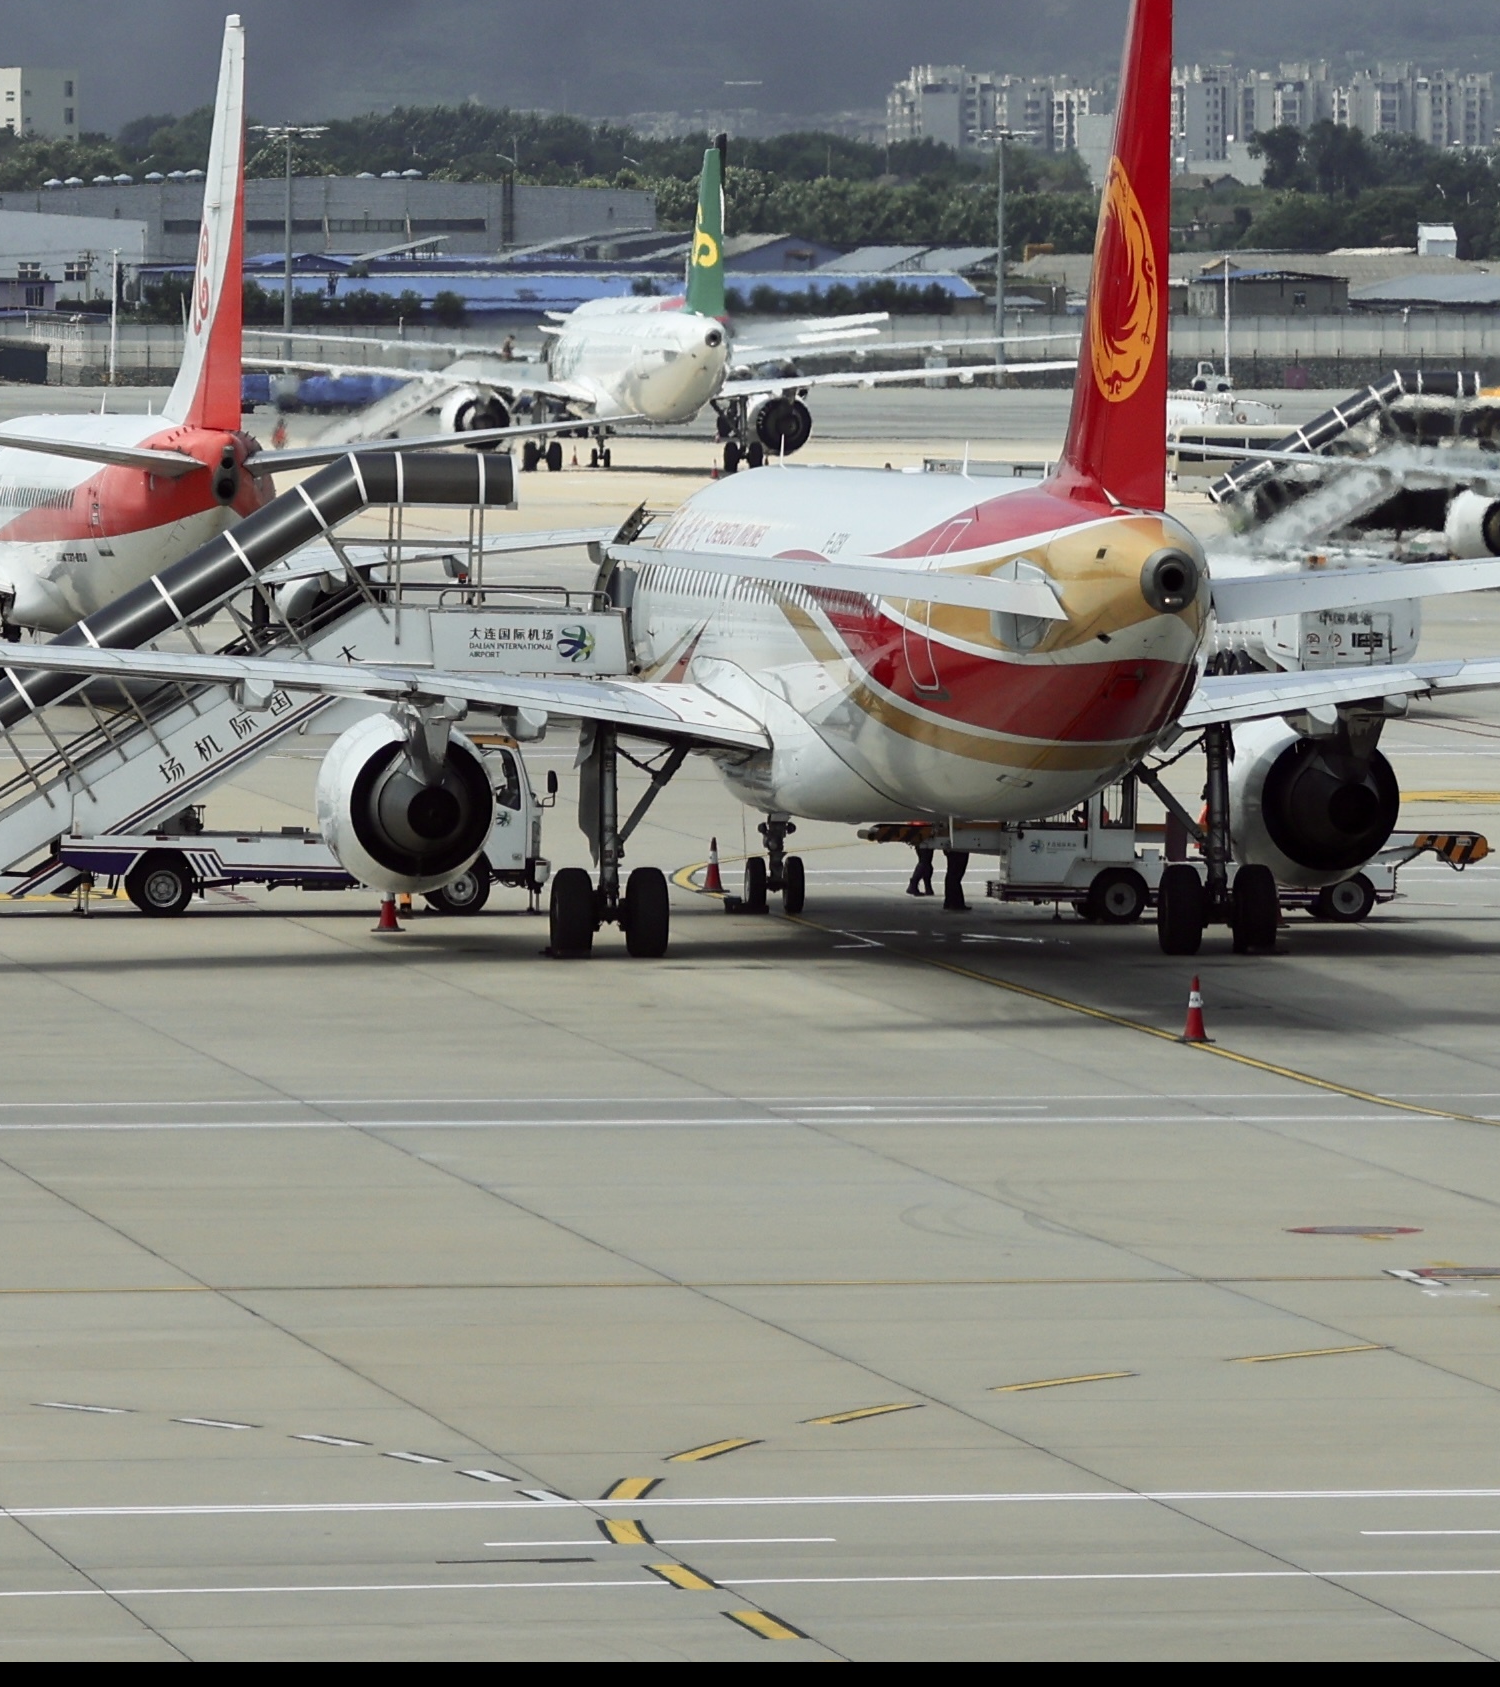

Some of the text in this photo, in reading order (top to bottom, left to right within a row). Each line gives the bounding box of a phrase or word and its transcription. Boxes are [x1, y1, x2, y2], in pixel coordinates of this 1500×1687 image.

[469, 627, 554, 642] 大连国际机场
[469, 643, 554, 651] DALIAN INTERNATIONAL
